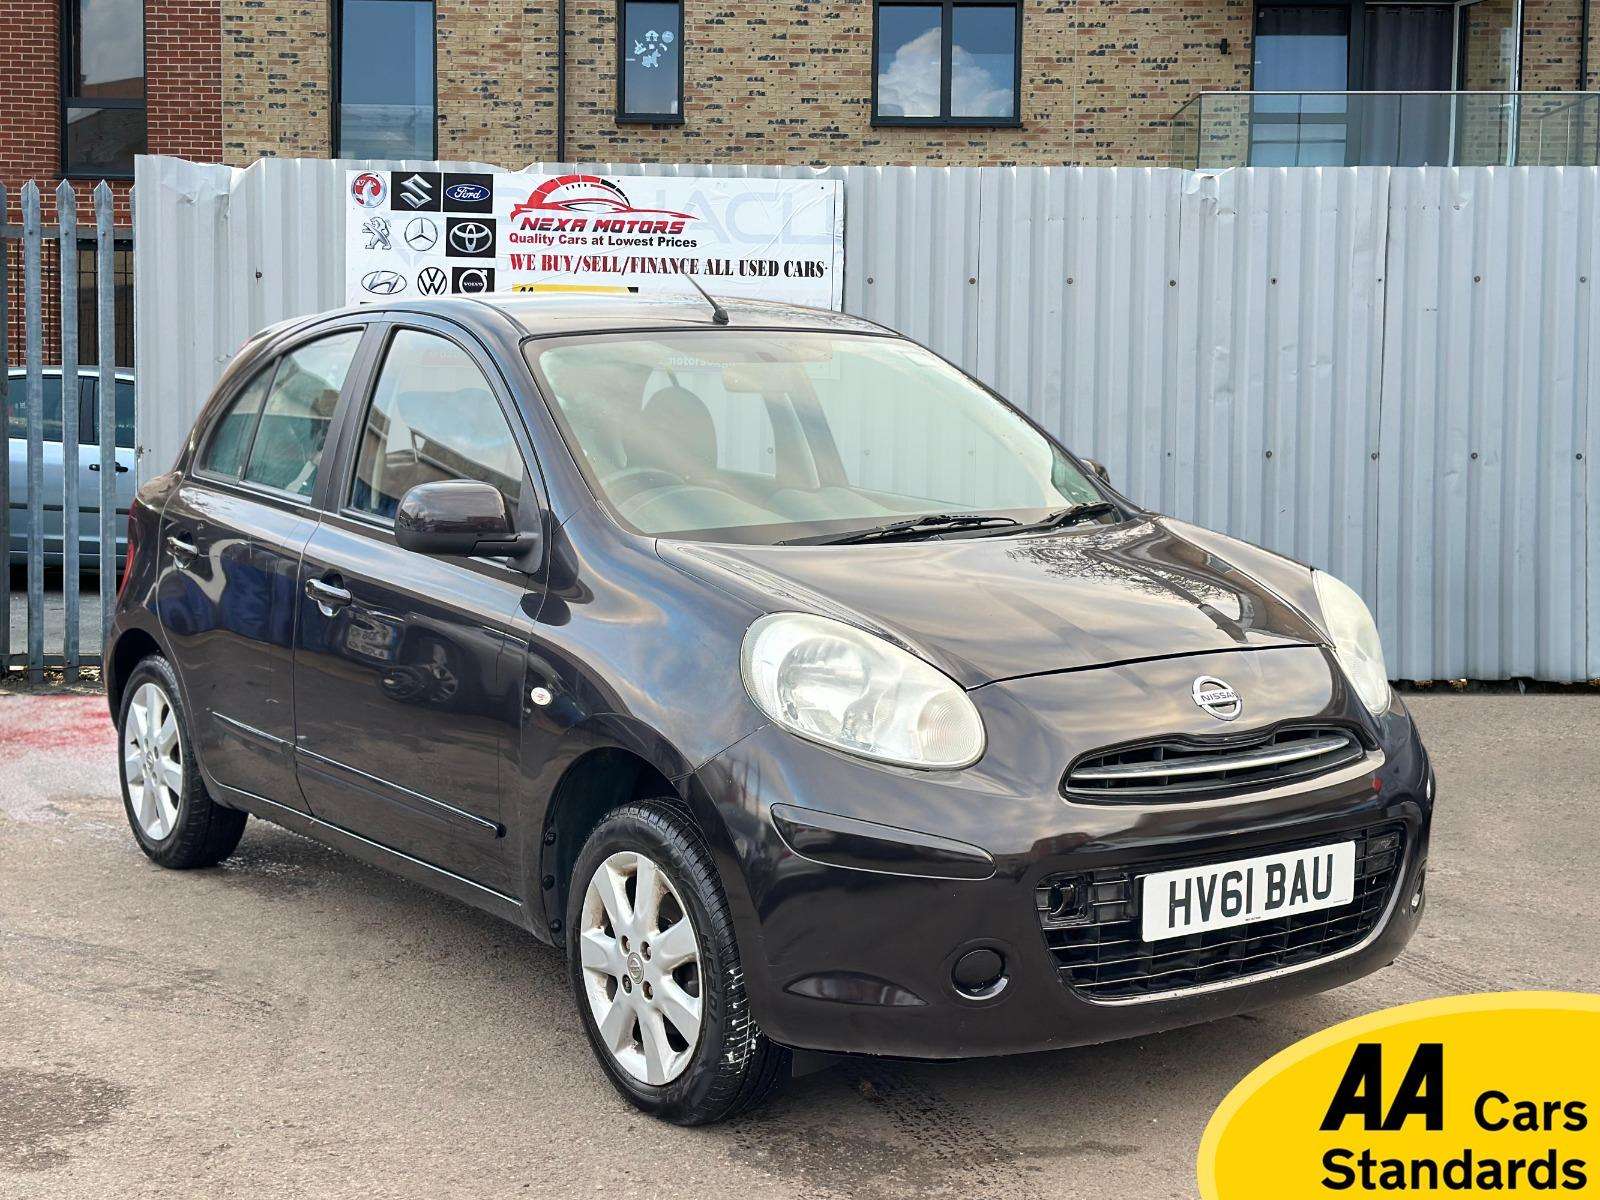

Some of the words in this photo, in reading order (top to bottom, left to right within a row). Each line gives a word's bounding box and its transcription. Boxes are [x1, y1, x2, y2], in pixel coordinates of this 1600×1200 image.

[454, 186, 482, 198] Ford
[519, 217, 588, 232] NEXA
[592, 219, 686, 235] MOTORS
[509, 233, 554, 246] Quality
[558, 234, 588, 245] Cars
[591, 236, 604, 245] at
[608, 235, 654, 247] Lowest
[657, 236, 697, 248] Prices
[510, 253, 536, 271] WE
[541, 254, 699, 275] BUY/SELL/FINANCE
[704, 258, 734, 276] ALL
[739, 259, 779, 277] USED
[783, 260, 825, 278] CARS
[1200, 690, 1238, 702] NISSAN
[1168, 867, 1254, 929] HV61
[1264, 853, 1334, 911] BAU
